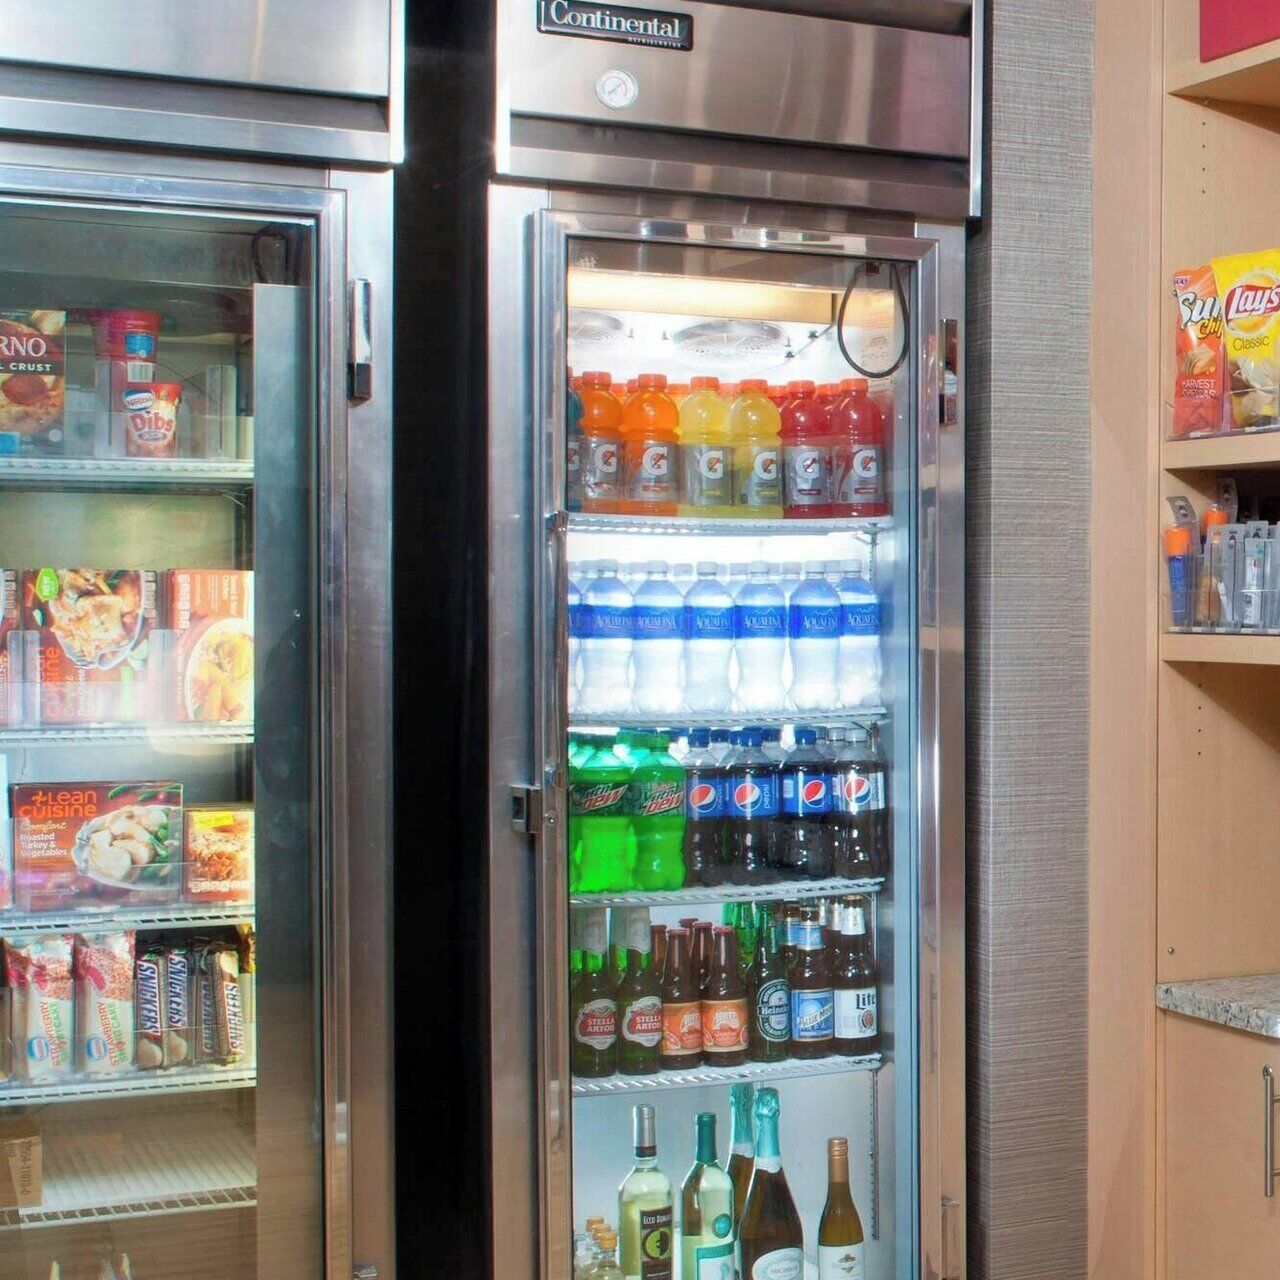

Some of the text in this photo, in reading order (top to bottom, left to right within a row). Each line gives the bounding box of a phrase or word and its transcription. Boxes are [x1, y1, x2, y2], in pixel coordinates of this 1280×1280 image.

[550, 0, 681, 39] Continental
[1233, 336, 1270, 351] Classic
[9, 362, 52, 372] CRUST
[130, 412, 174, 432] Dibs
[642, 446, 668, 475] G
[700, 450, 724, 479] G
[754, 451, 777, 480] G
[853, 449, 878, 478] G
[48, 790, 97, 805] Lean
[763, 783, 771, 809] pepsi
[18, 804, 98, 818] cuisine
[20, 840, 49, 849] Turkey
[20, 848, 67, 857] Vegetables
[139, 963, 159, 1034] SNICKERS
[169, 956, 187, 1025] SNICKERS
[225, 984, 244, 1052] SNICKERS
[40, 1000, 61, 1067] STRAWBERRY
[97, 1000, 119, 1067] STRAWBERRY
